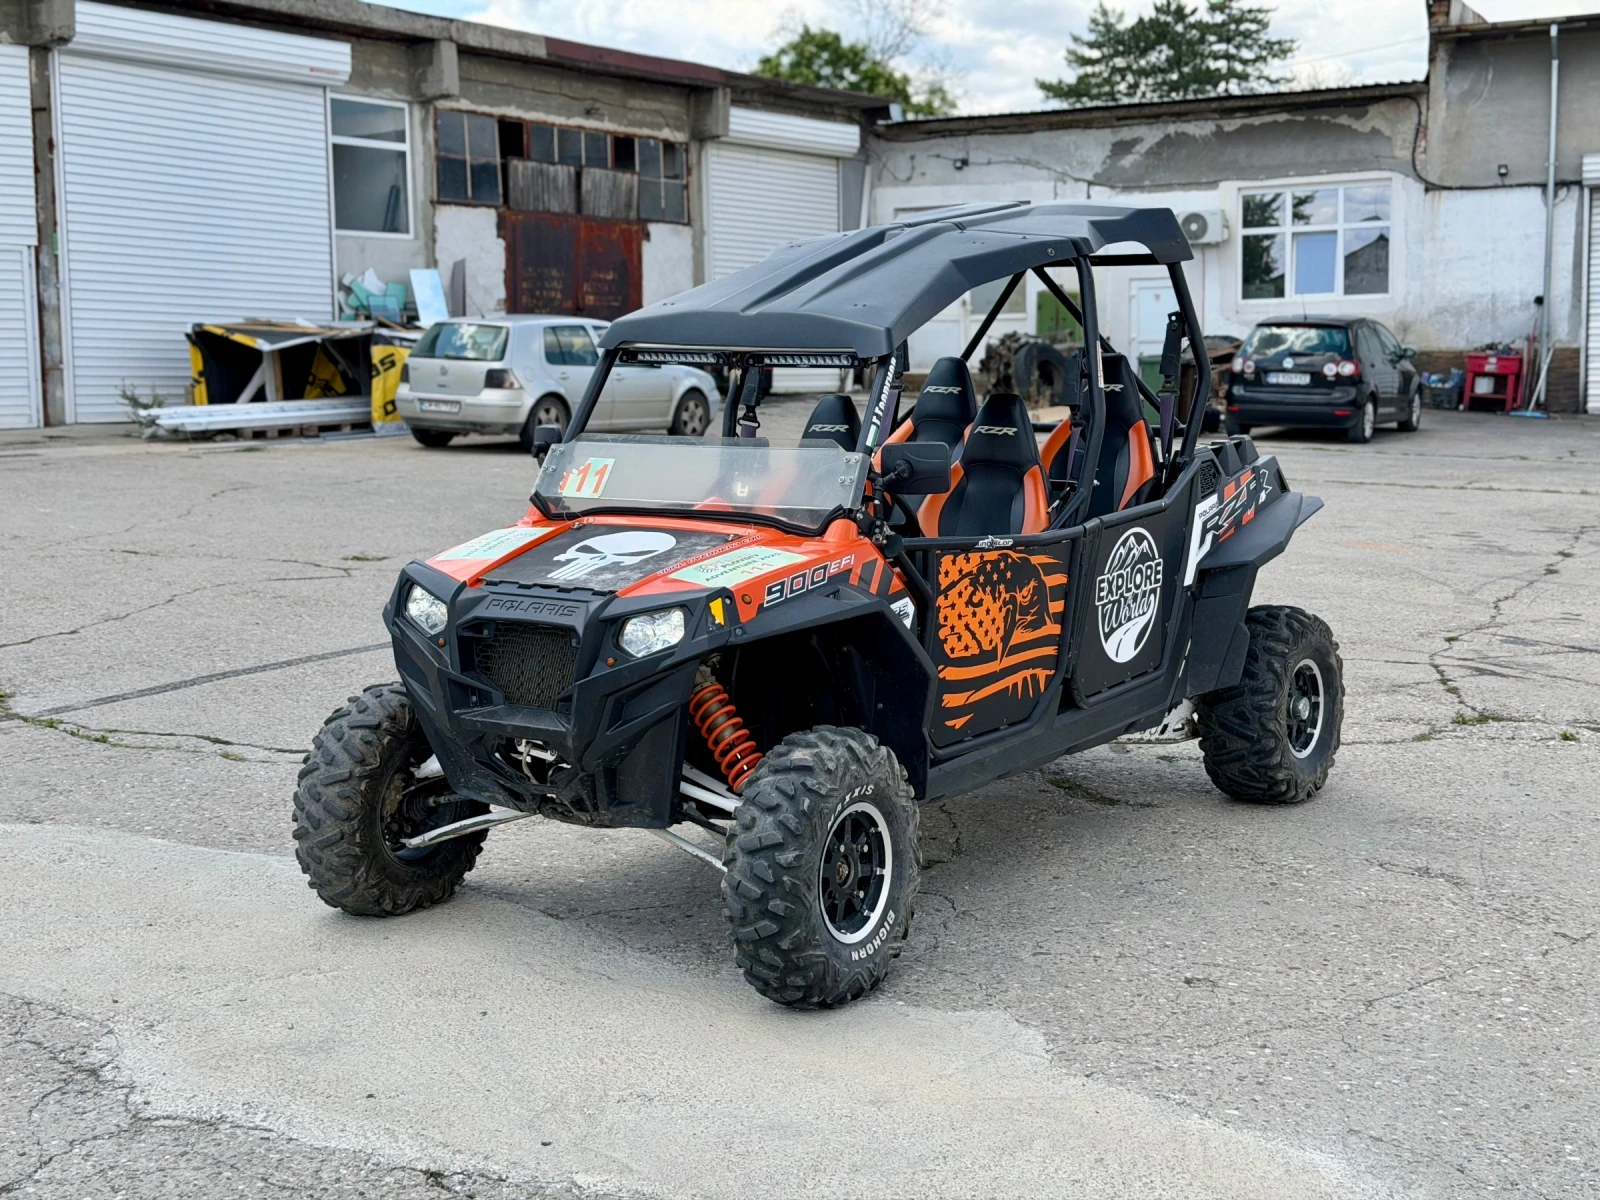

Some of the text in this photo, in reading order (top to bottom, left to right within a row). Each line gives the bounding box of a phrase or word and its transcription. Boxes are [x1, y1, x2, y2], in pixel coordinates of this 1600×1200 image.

[922, 385, 963, 395] RZR
[808, 424, 850, 433] RZR
[973, 425, 1018, 436] RZR
[1198, 501, 1220, 519] POLARIS
[705, 559, 758, 582] ADVENTURE
[740, 562, 775, 575] 111
[763, 554, 855, 607] 900 EFI
[1096, 559, 1163, 605] EXPLORE
[485, 598, 580, 617] POLARIS
[1103, 589, 1152, 633] World
[850, 908, 896, 962] BIGHORN
